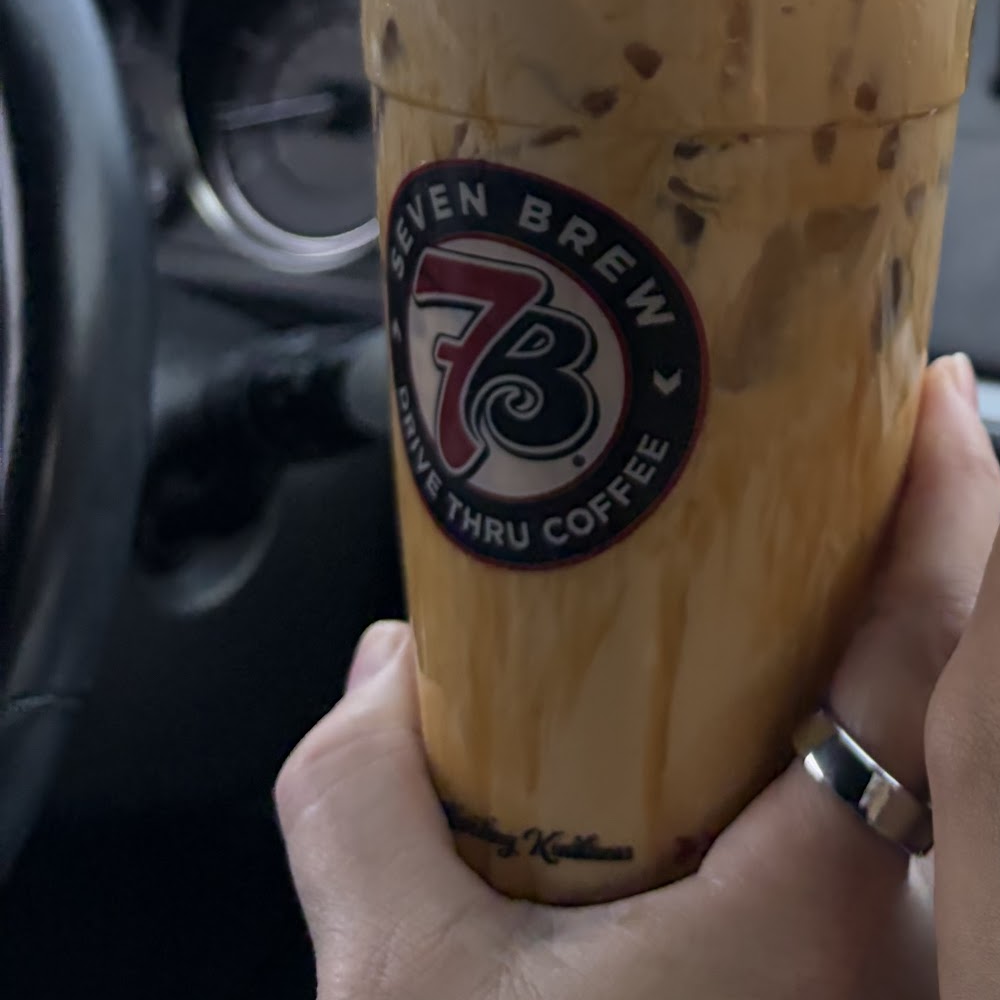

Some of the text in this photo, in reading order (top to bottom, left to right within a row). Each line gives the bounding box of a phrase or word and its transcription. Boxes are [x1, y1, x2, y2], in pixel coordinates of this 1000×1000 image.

[390, 180, 676, 328] SEVEN BREW
[398, 386, 670, 549] DRIVE THRU COFFEE
